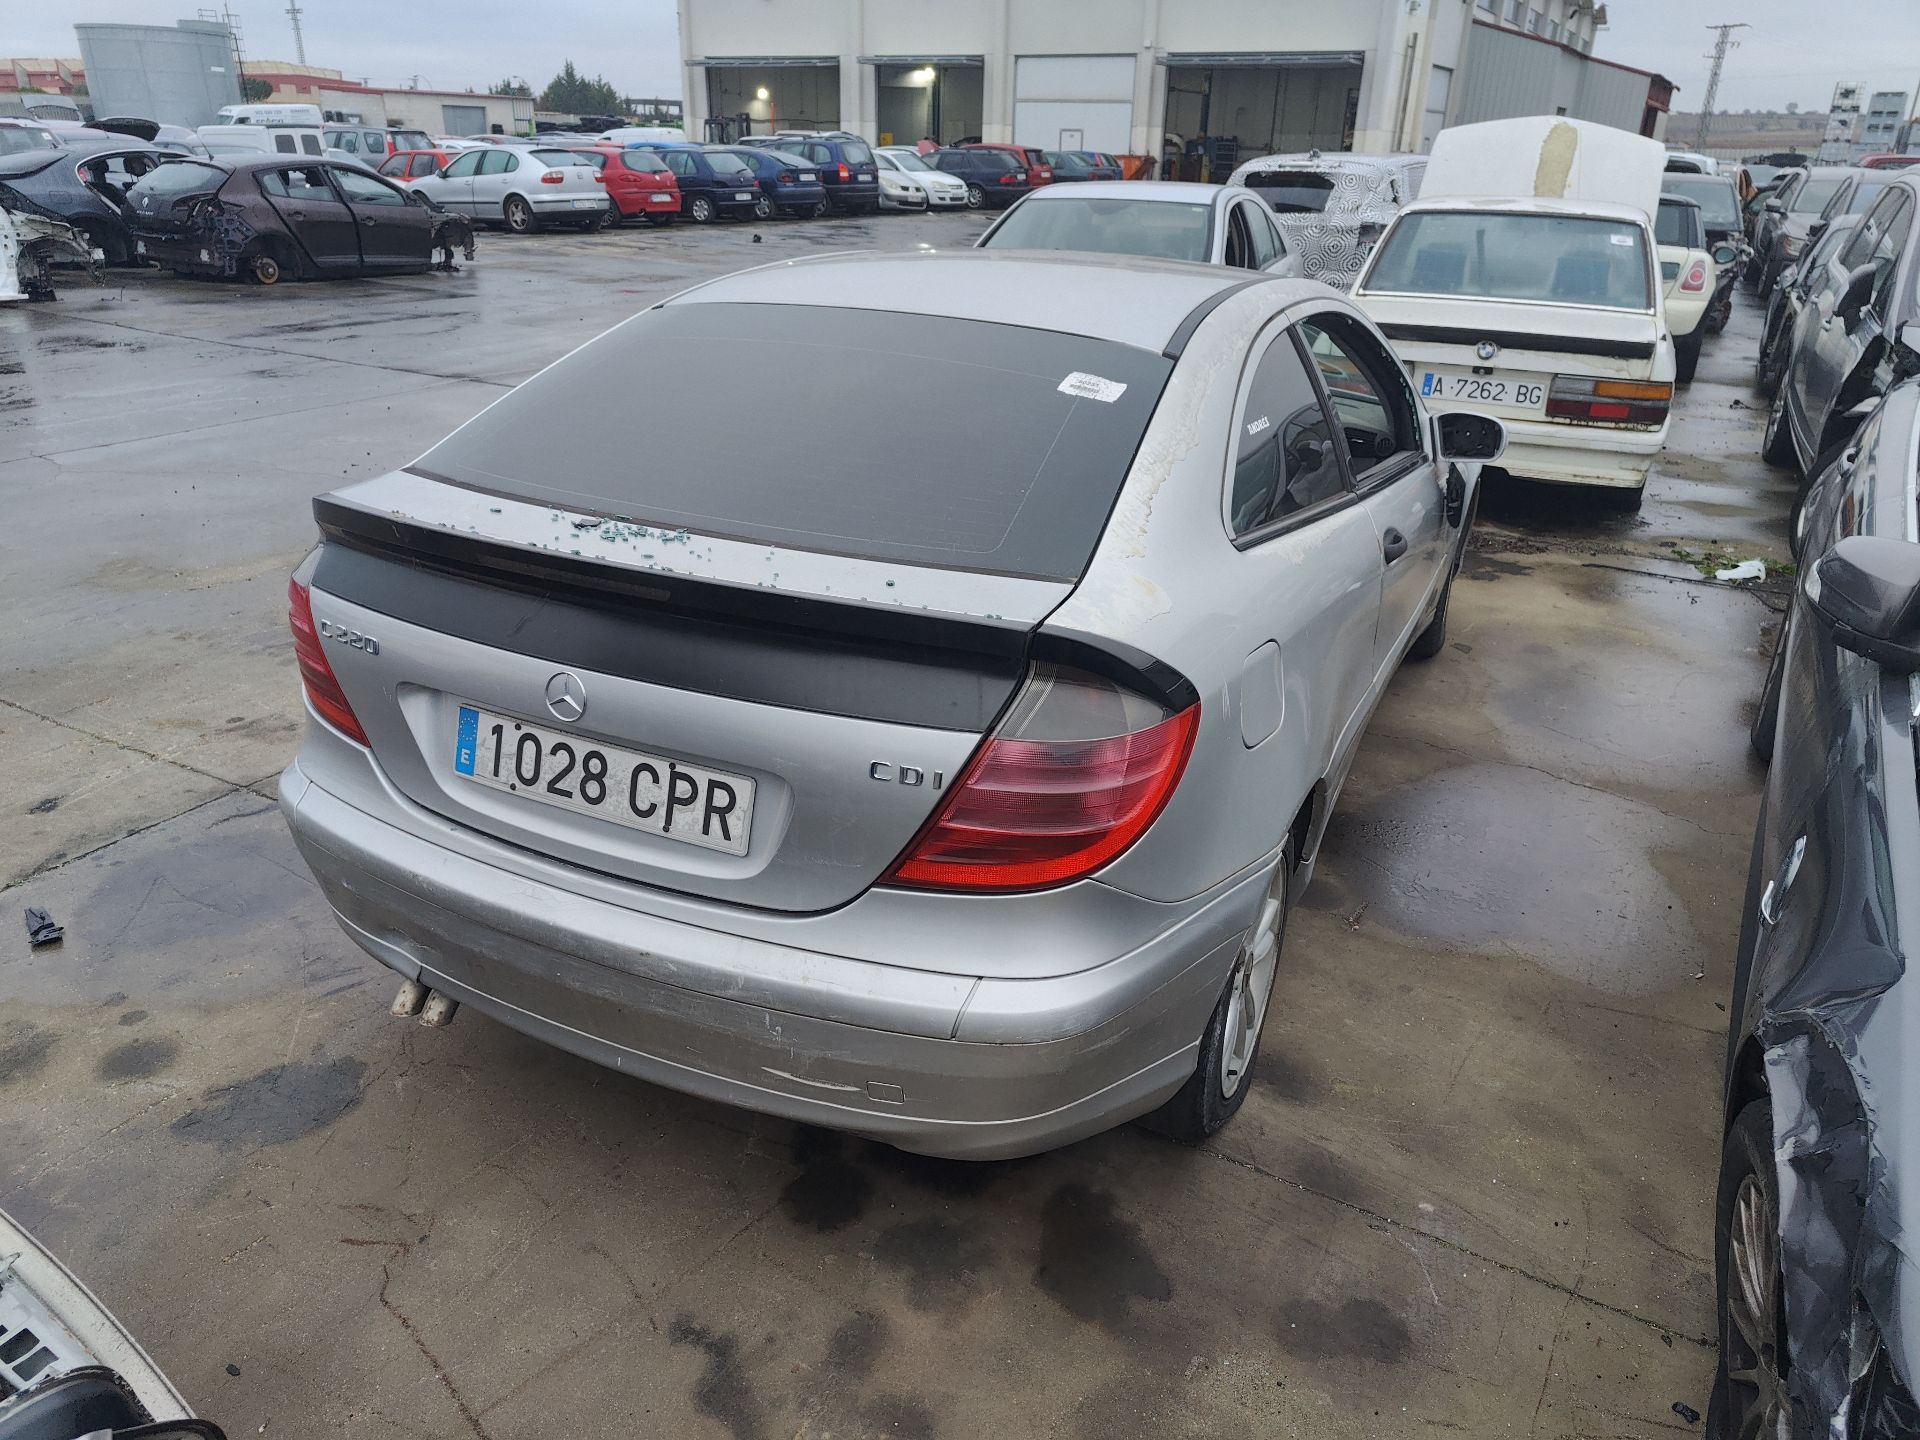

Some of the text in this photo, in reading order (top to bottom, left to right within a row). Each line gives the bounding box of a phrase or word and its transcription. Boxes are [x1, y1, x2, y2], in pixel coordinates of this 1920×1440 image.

[1432, 376, 1543, 405] A 7262 BG
[460, 723, 737, 842] E 1028 CPR
[869, 759, 943, 790] CDI
